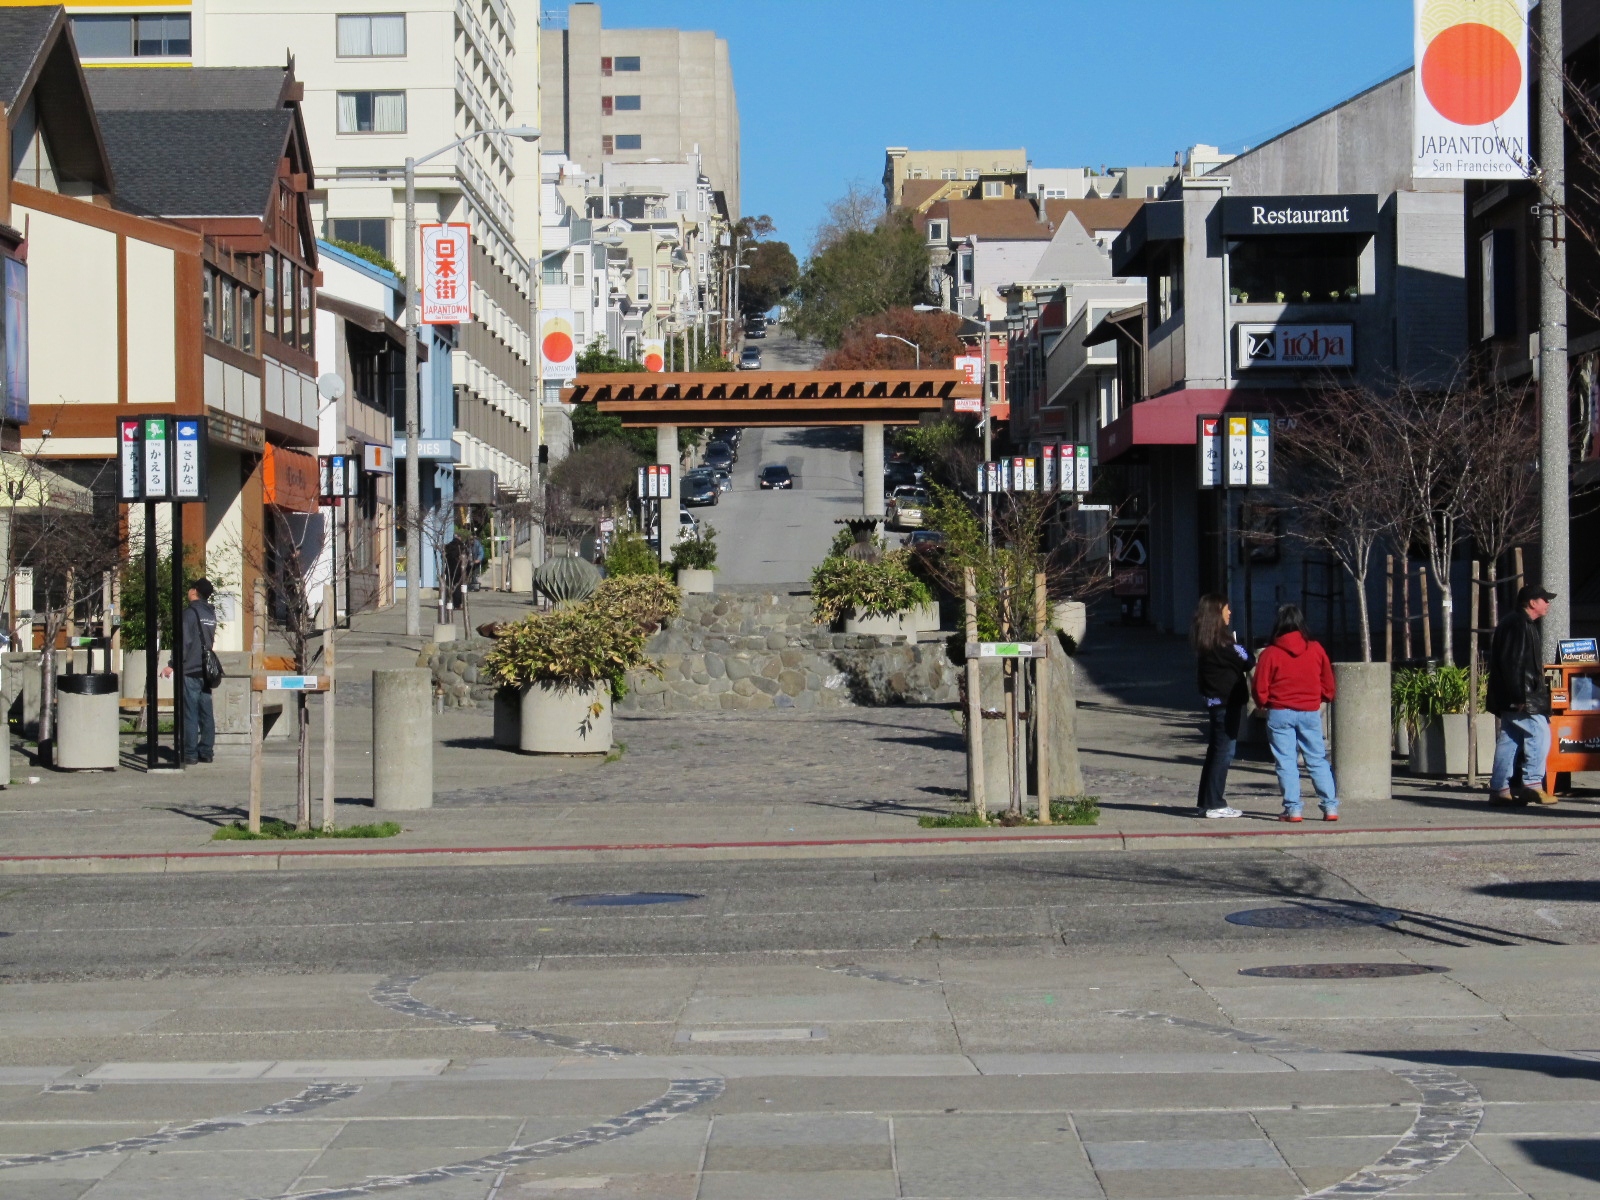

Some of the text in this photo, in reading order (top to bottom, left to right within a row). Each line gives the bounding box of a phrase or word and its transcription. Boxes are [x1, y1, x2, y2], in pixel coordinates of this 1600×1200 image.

[1418, 135, 1523, 158] JAPANTOWN
[1432, 159, 1512, 173] San Francisco
[1252, 206, 1350, 225] Restaurant
[435, 239, 456, 299] 日本街
[425, 305, 468, 315] JAPANTOWN
[401, 443, 440, 455] CPIES
[1207, 448, 1218, 471] ねこ
[1232, 448, 1243, 470] いぬ
[1254, 449, 1266, 471] つる
[150, 449, 161, 484] かえる
[183, 451, 194, 485] さかな
